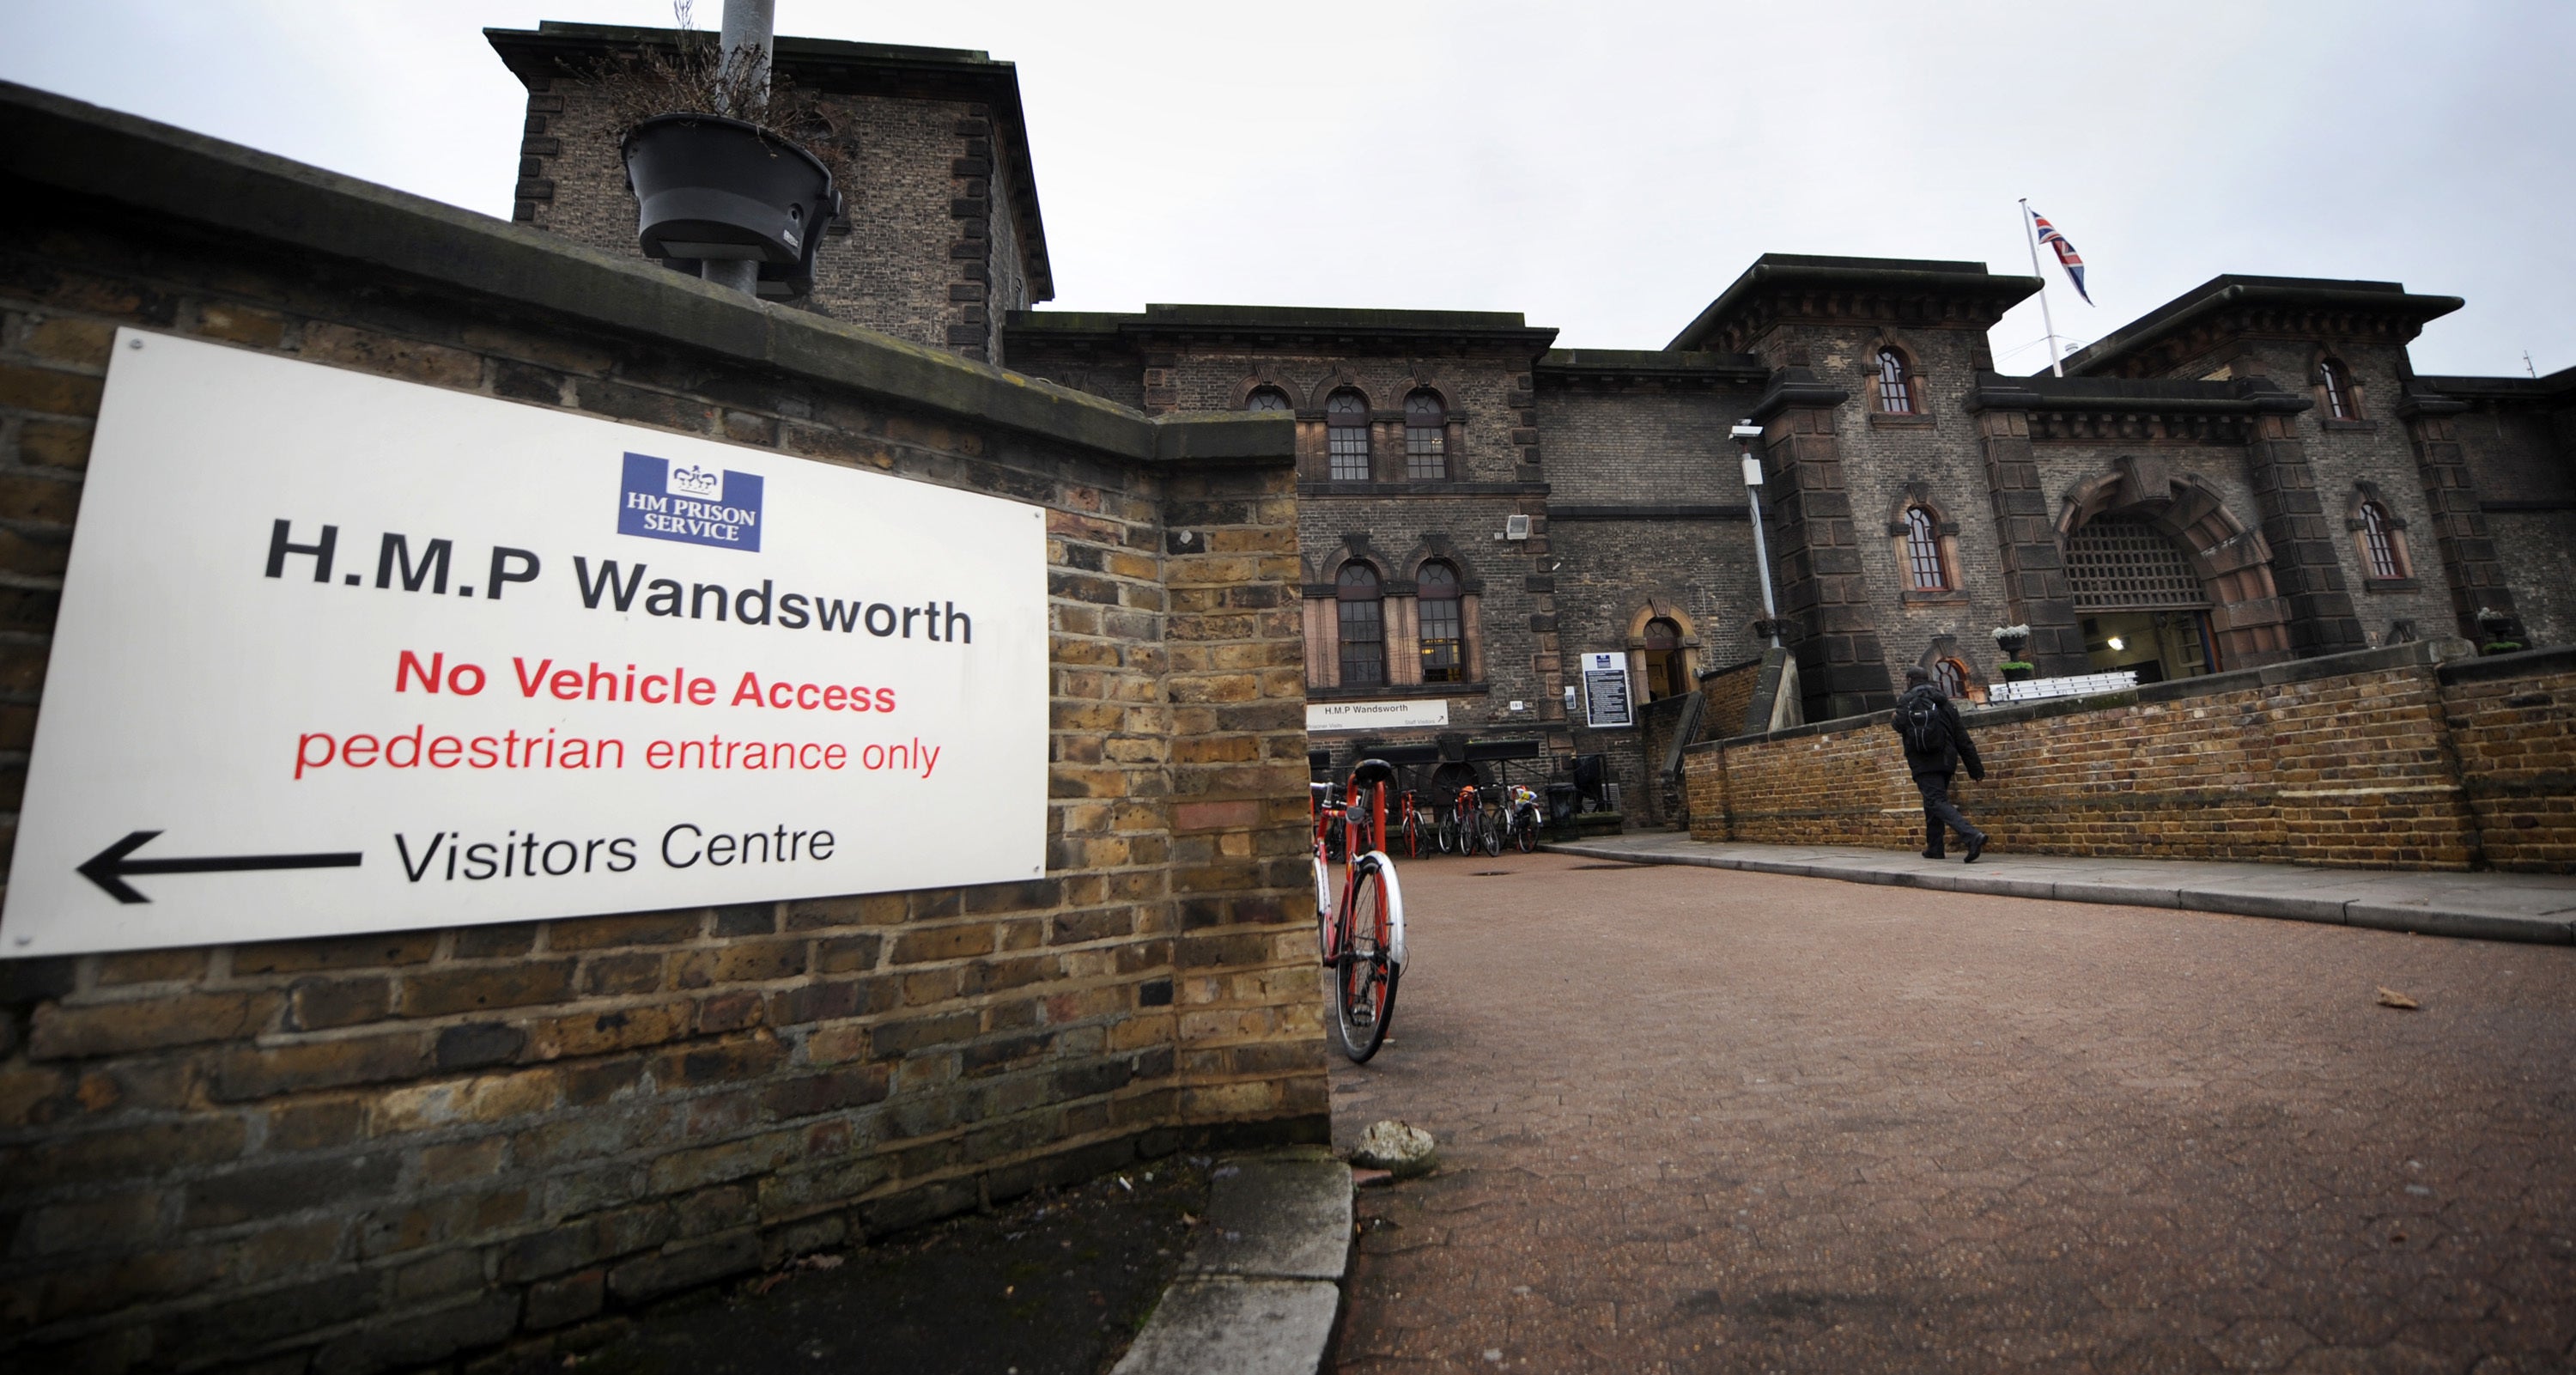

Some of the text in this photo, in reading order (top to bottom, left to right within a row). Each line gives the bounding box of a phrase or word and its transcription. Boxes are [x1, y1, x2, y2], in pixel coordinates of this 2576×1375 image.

[627, 492, 756, 526] HM PRISON
[644, 514, 739, 541] SERVICE
[265, 519, 972, 644] H.M.P Wandsworth
[395, 650, 896, 713] No Vehicle Access
[1353, 704, 1408, 714] Wandsworth
[294, 724, 941, 781] pedestrian entrance only
[393, 823, 835, 884] Visitors Centre
